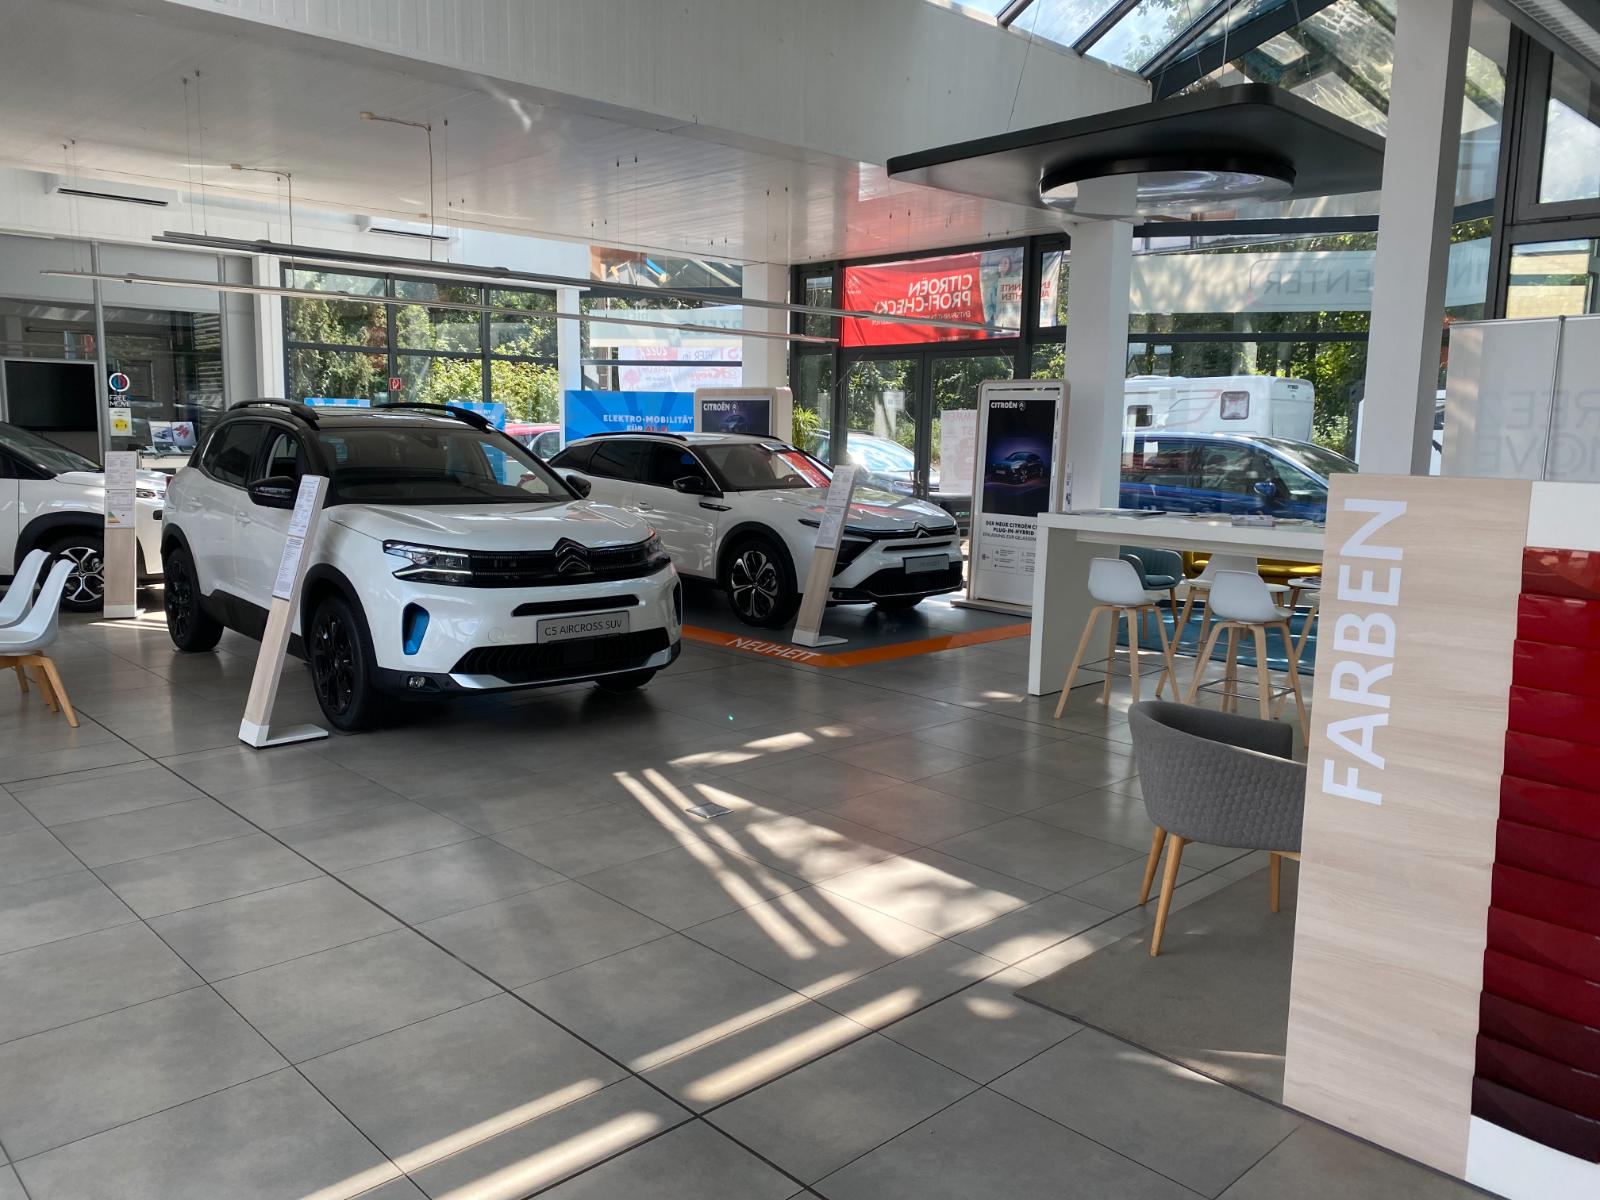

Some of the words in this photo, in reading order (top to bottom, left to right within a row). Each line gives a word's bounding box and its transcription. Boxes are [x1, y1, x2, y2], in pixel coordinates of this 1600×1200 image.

[703, 403, 730, 411] CITROËN
[991, 401, 1018, 409] CITROËN
[544, 626, 558, 637] C5
[559, 621, 604, 635] AIRCROSS
[605, 619, 622, 630] SUV
[725, 637, 821, 661] NEUHEIT
[1322, 498, 1407, 806] FARBEN
